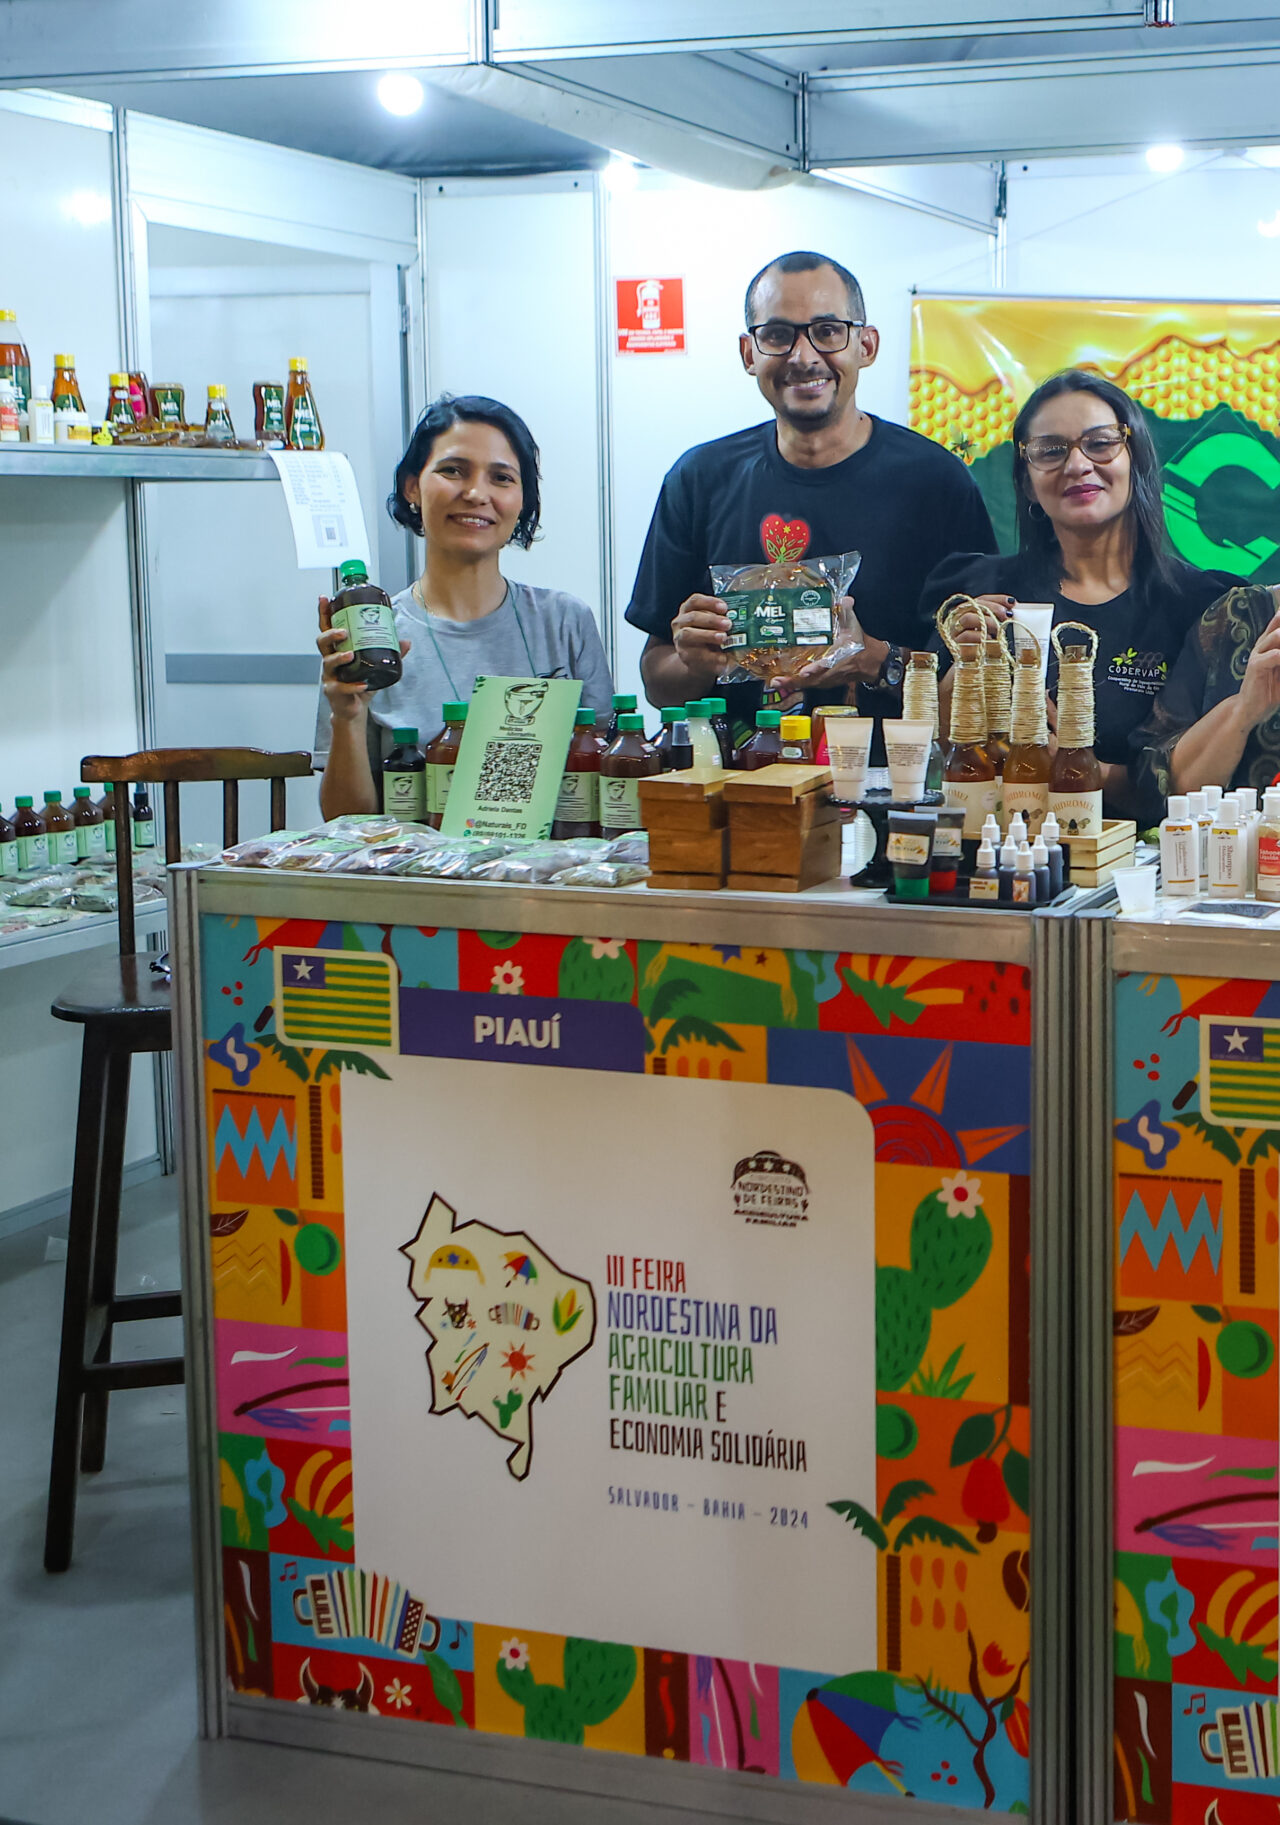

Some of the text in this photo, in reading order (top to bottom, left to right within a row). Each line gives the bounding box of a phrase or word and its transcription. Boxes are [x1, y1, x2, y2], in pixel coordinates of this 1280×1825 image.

[755, 605, 785, 618] MEL
[1108, 665, 1160, 677] CODERVAP
[475, 819, 527, 830] @Naturais_FD
[474, 1012, 562, 1049] PIAUÍ
[738, 1181, 804, 1198] NORDESTINO
[742, 1194, 756, 1204] DE
[606, 1254, 686, 1293] III FEIRA
[607, 1291, 778, 1345] NORDESTINA DA
[608, 1333, 753, 1384] AGRICULTURA
[609, 1374, 727, 1422] FAMILIAR E
[610, 1418, 808, 1472] ECONOMIA SOLIDÁRIA
[608, 1486, 679, 1512] SALVADOR
[703, 1498, 746, 1520] BAHIA
[770, 1506, 808, 1529] 2024
